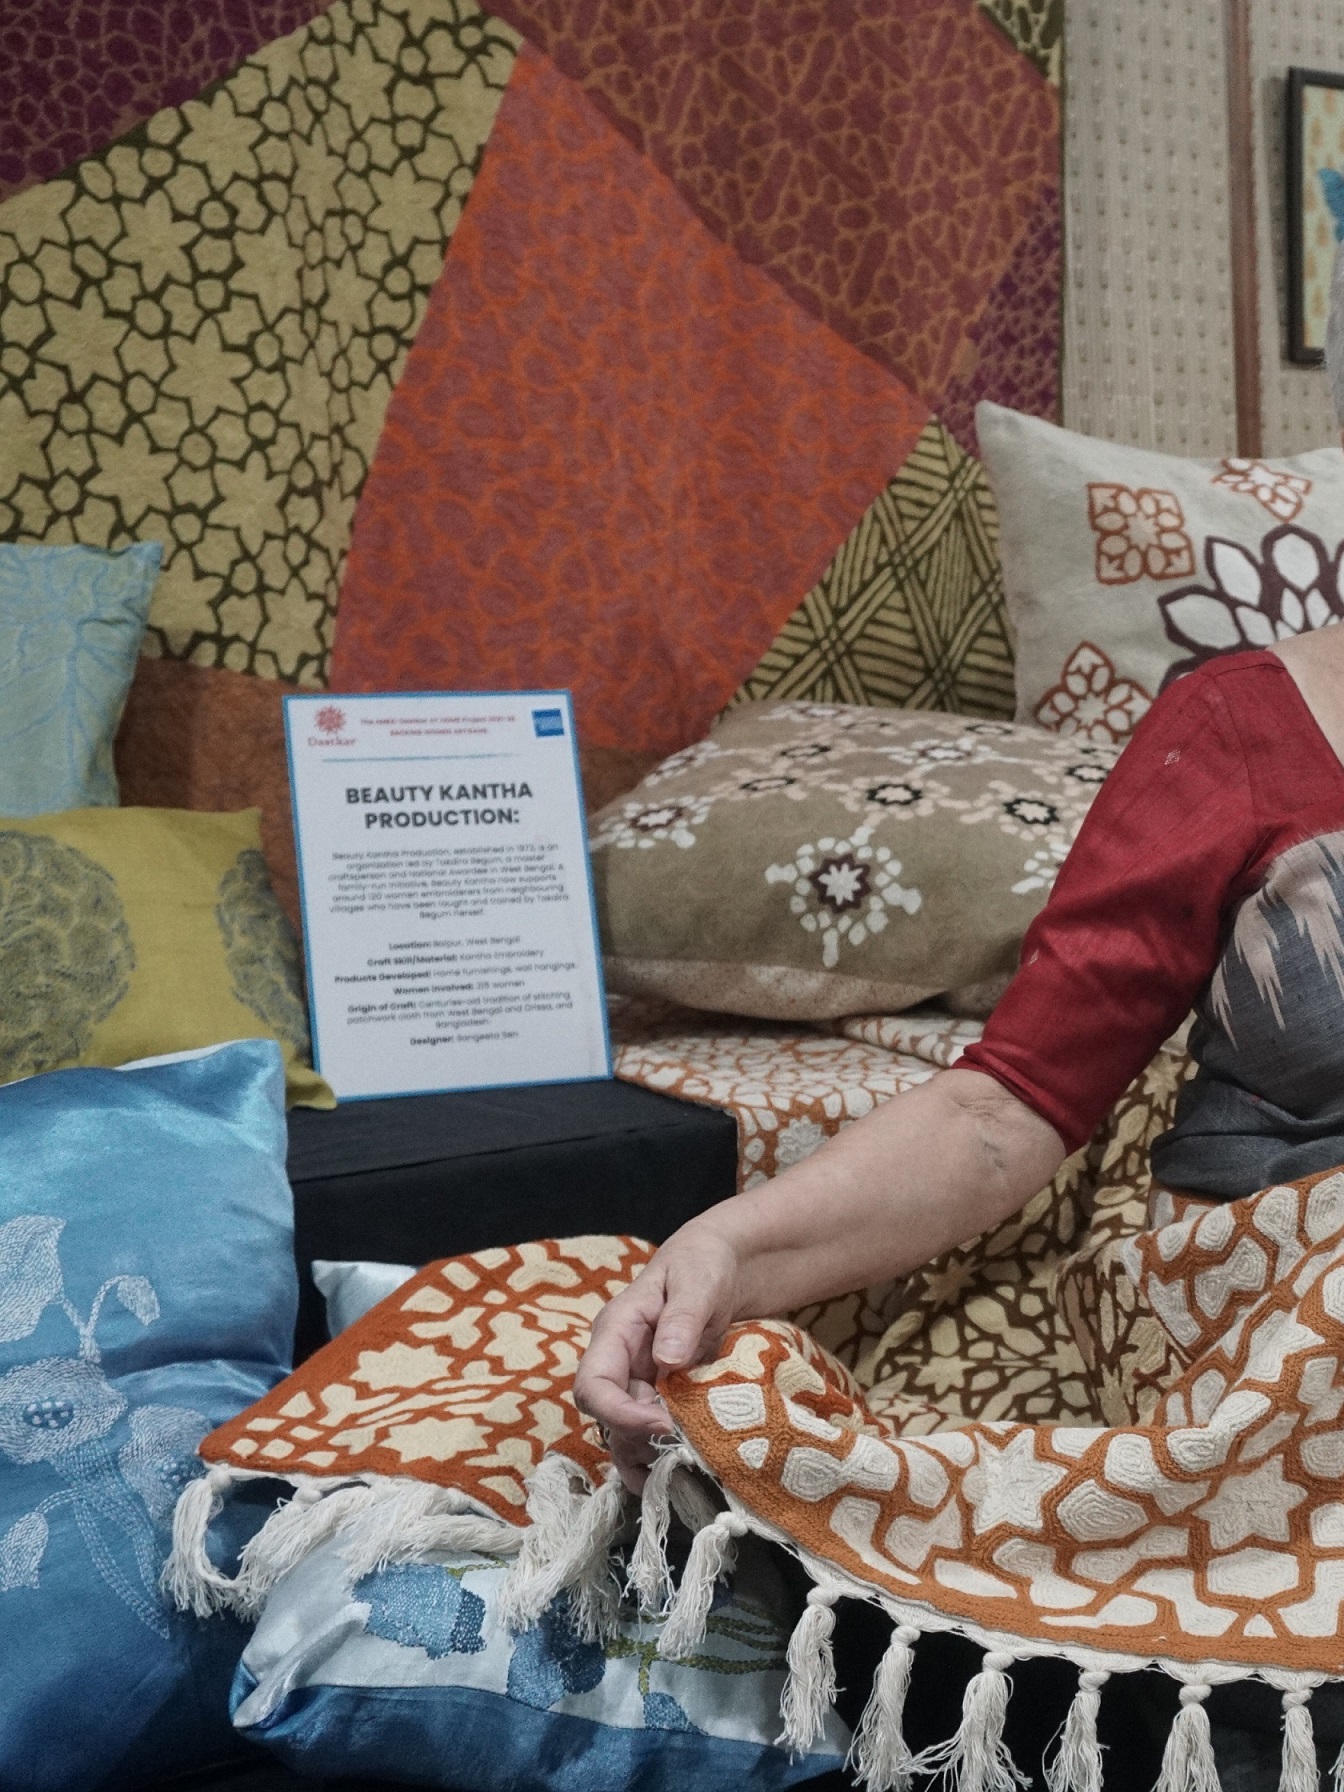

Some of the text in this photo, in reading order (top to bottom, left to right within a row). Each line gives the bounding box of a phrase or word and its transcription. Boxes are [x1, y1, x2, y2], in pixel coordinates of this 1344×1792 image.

[345, 782, 533, 804] BEAUTY KANTHA
[364, 807, 520, 829] PRODUCTION:
